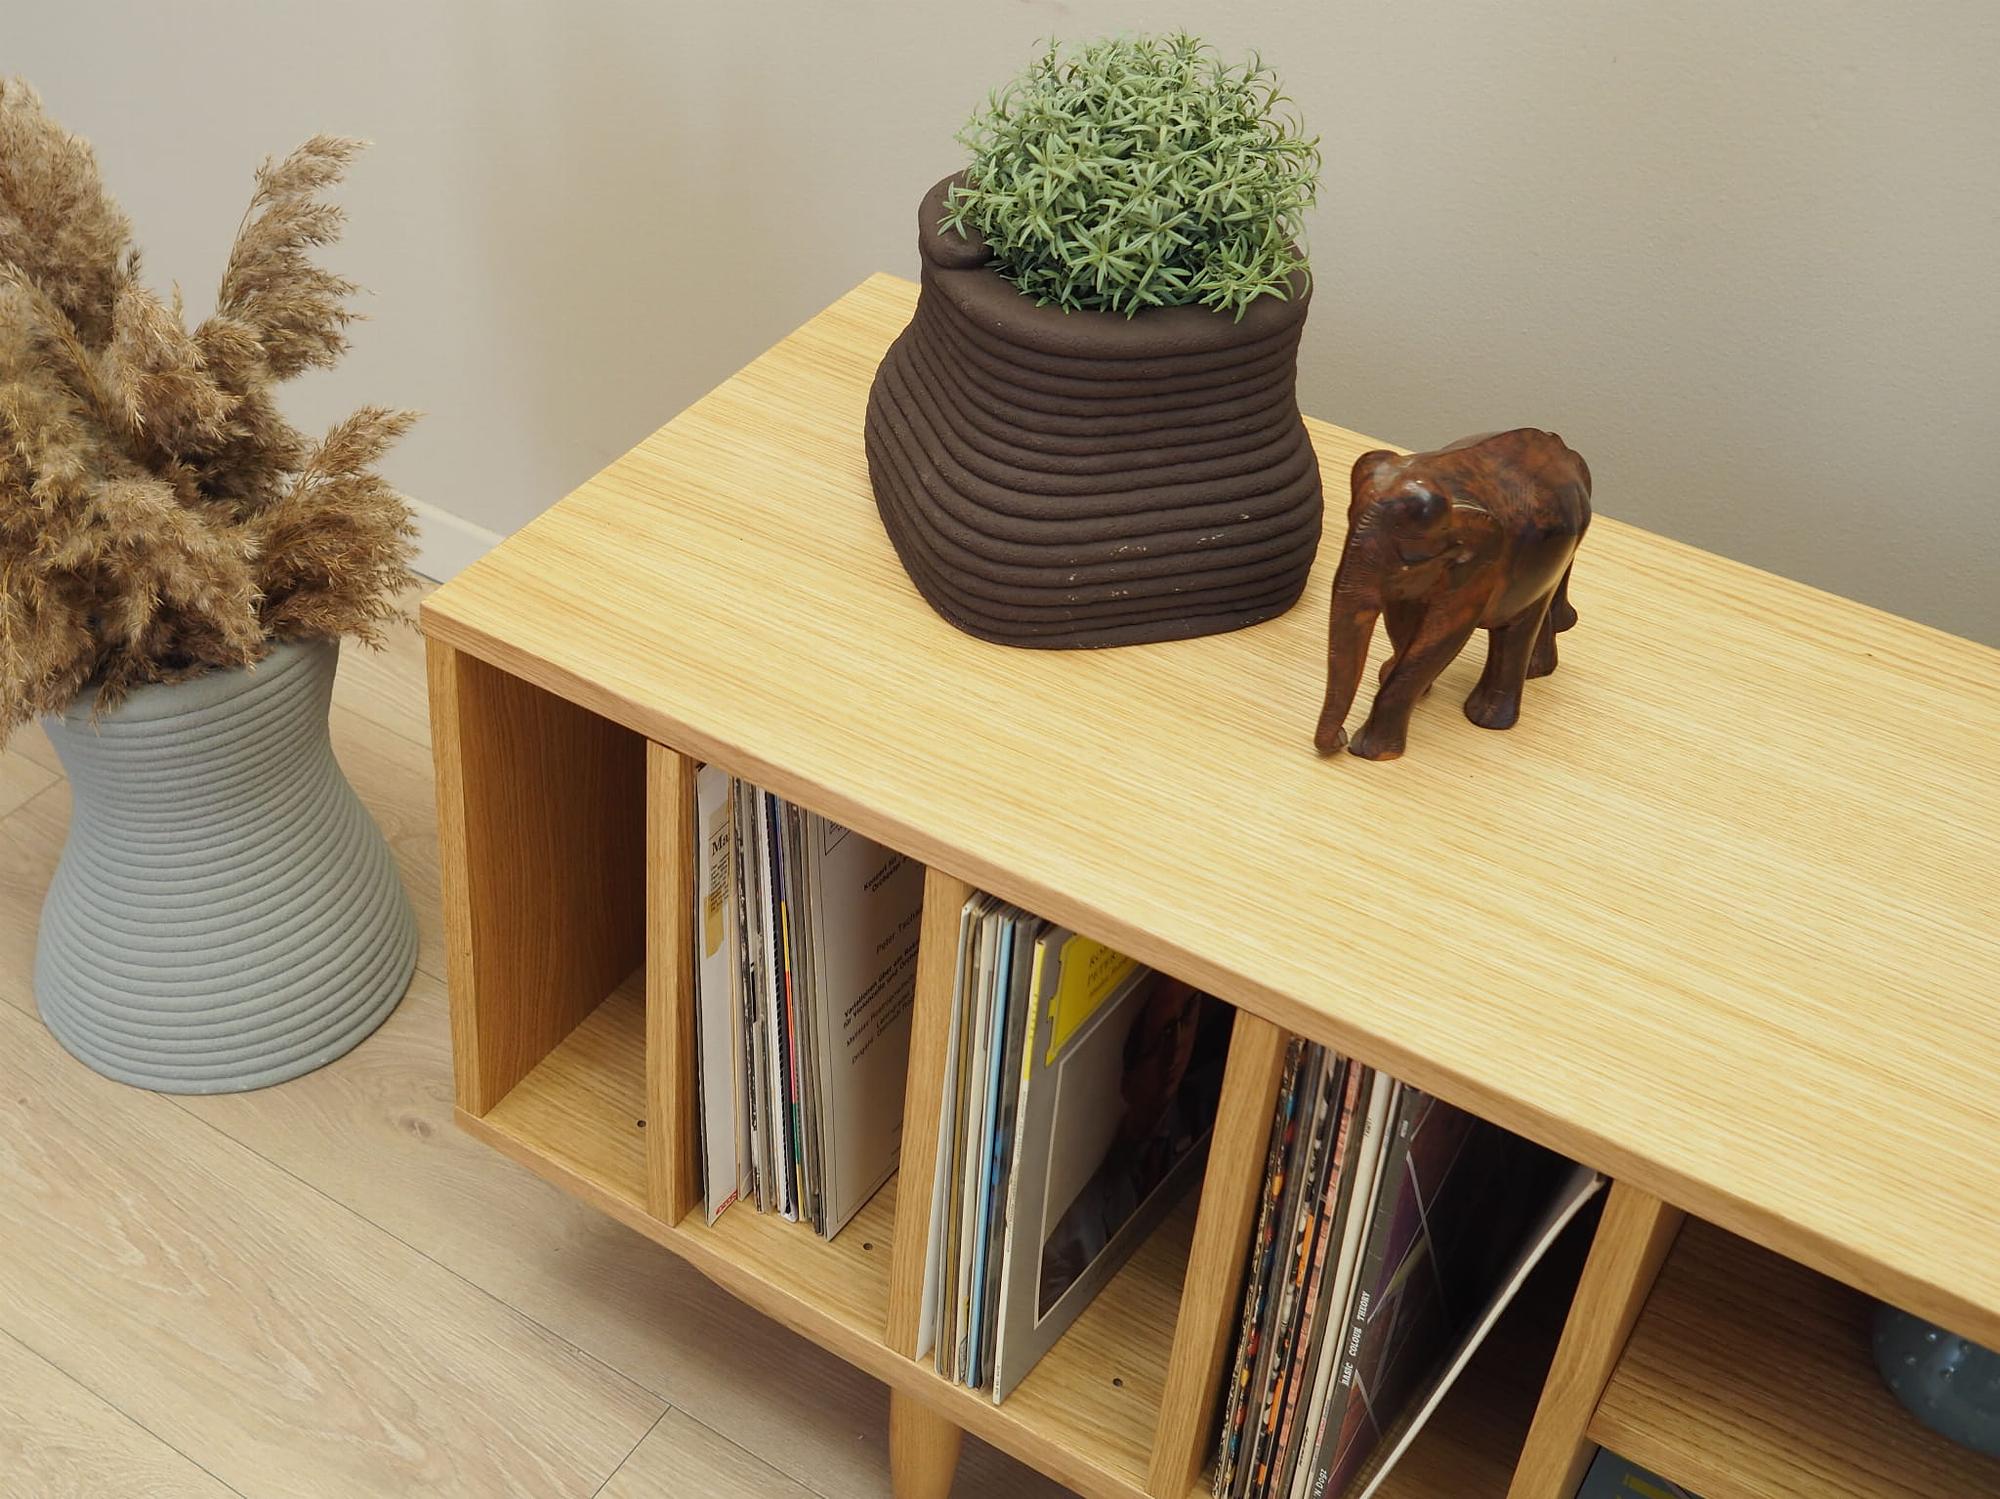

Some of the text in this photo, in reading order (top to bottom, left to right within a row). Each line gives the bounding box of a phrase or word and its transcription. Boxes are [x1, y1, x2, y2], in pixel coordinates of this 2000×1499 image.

[1341, 1290, 1371, 1388] BASIC COLOUR THEORY
